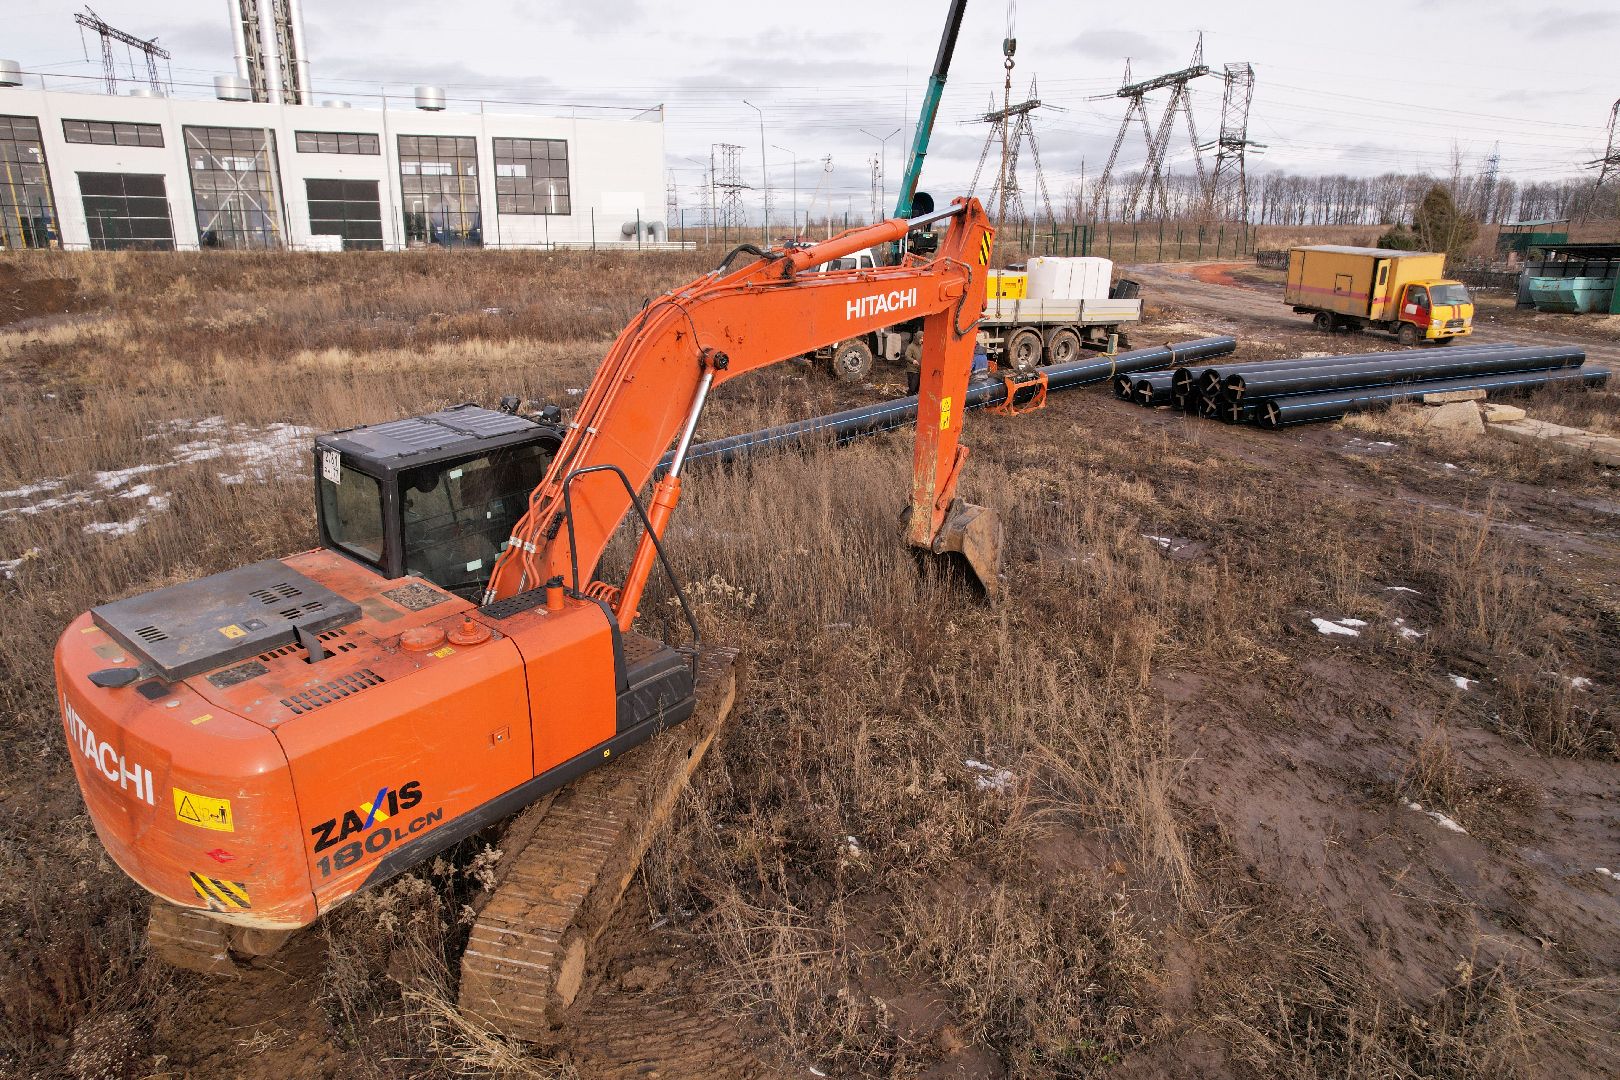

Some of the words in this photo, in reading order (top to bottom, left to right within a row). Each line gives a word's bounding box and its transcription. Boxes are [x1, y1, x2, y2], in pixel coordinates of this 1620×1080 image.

[846, 287, 917, 321] HITACHI
[63, 692, 155, 806] HITACHI
[311, 780, 423, 854] ZAXIS
